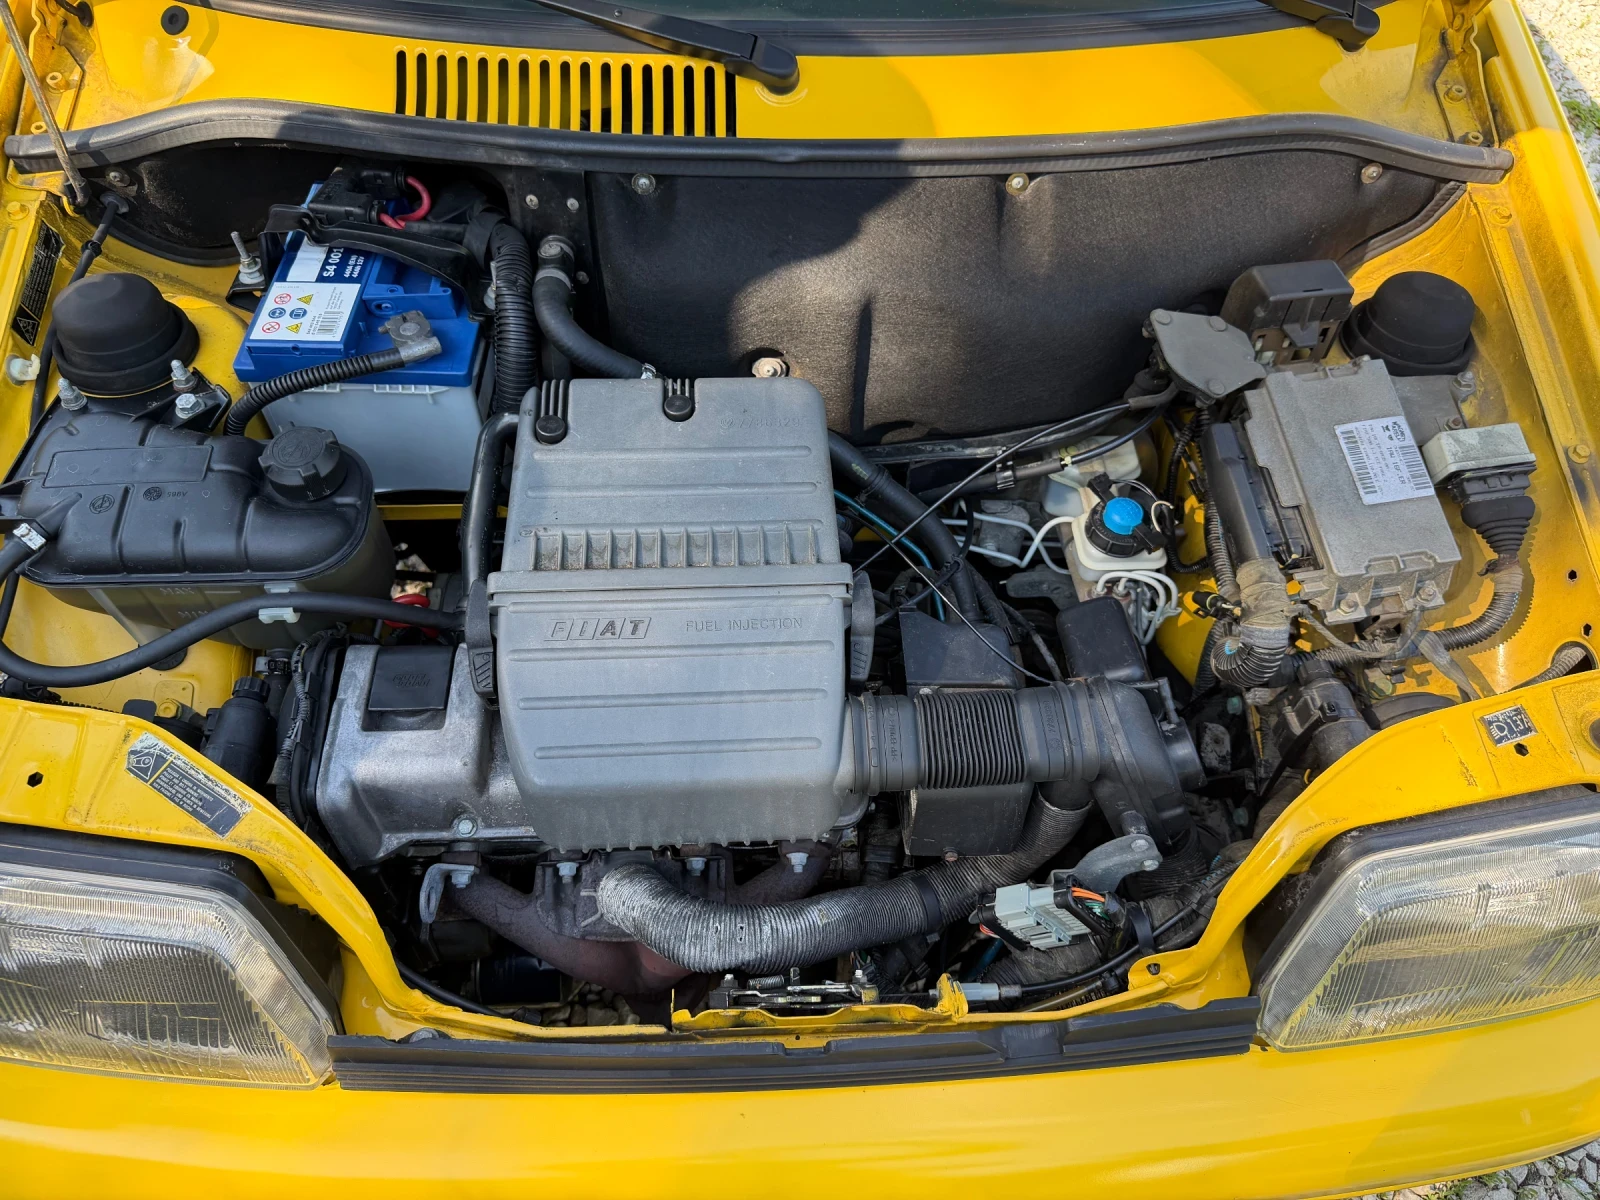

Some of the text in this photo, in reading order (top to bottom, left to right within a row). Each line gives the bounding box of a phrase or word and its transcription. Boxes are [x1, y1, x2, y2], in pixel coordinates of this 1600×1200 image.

[328, 247, 344, 264] 001
[323, 264, 338, 277] S4
[159, 586, 195, 595] MAX
[550, 617, 648, 640] FIAT
[686, 617, 803, 633] FUEL INJECTION
